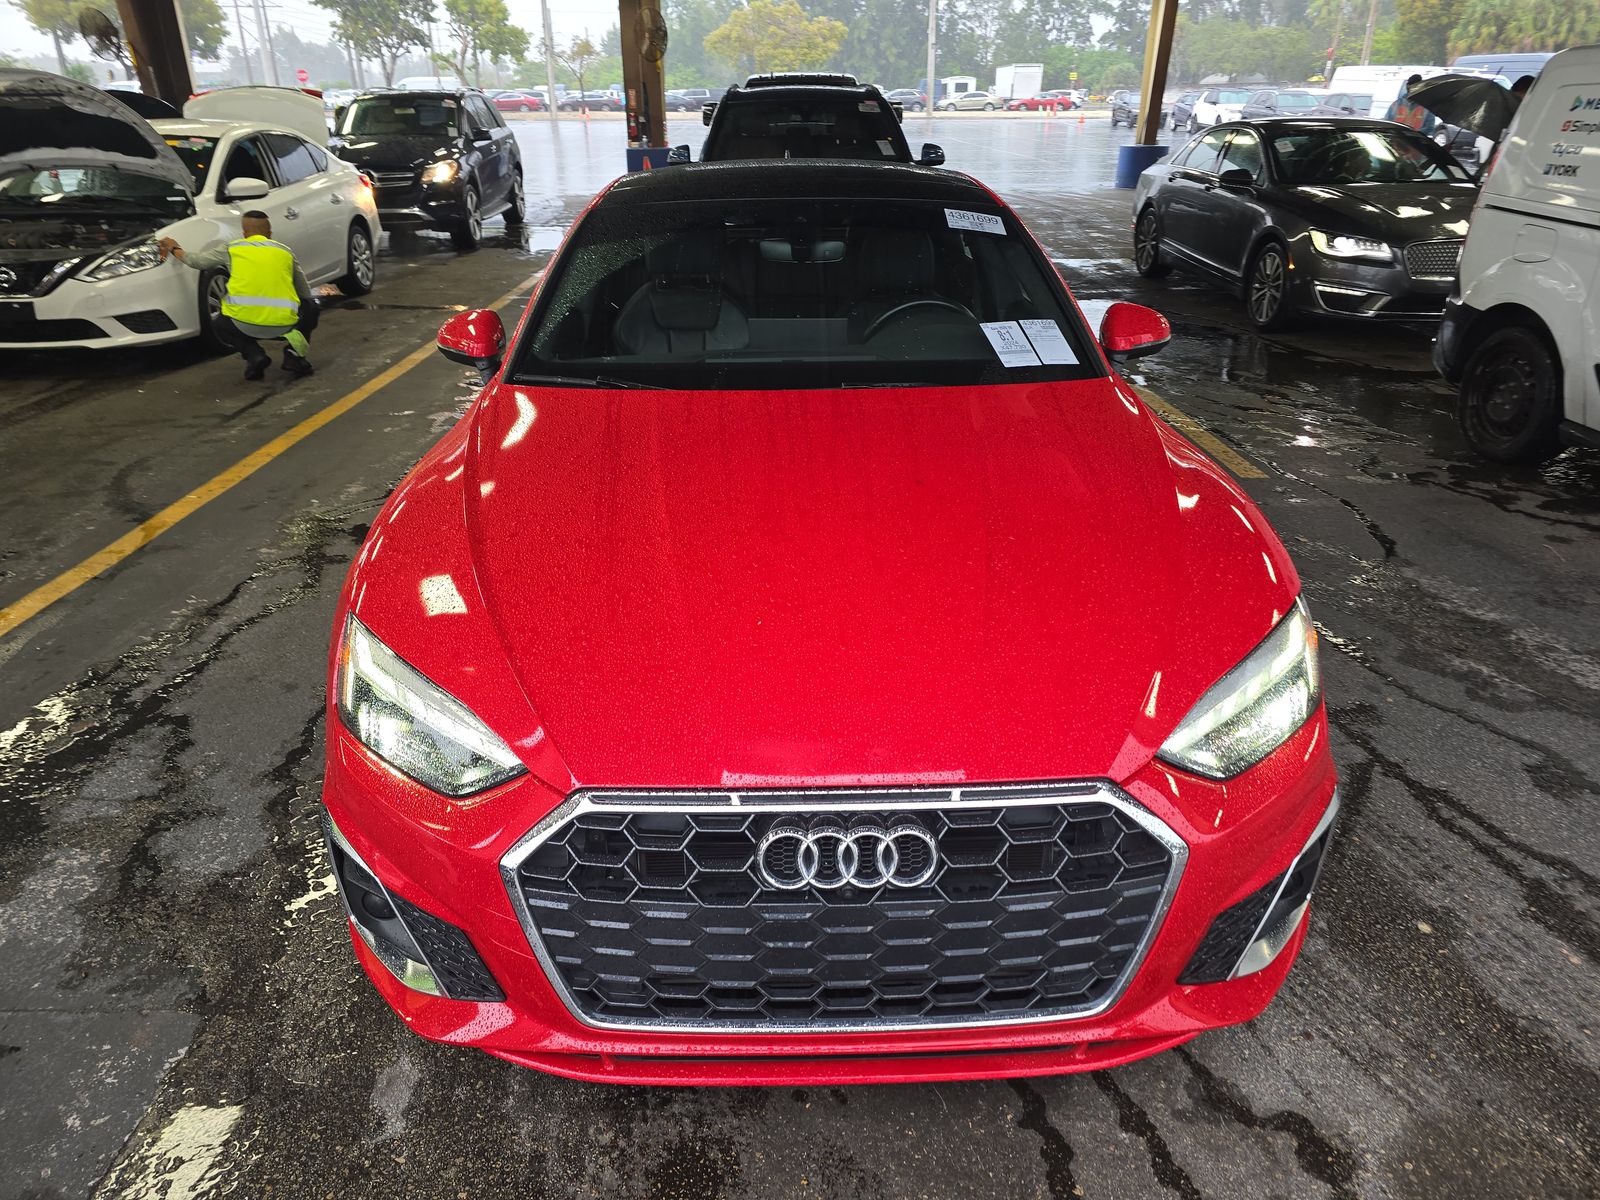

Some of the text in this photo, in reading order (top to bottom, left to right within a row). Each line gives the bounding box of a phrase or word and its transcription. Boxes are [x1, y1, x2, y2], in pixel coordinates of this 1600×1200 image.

[1552, 143, 1583, 157] tyco
[1552, 164, 1581, 177] YORK
[948, 211, 999, 225] 4361699
[997, 330, 1014, 341] 8:1
